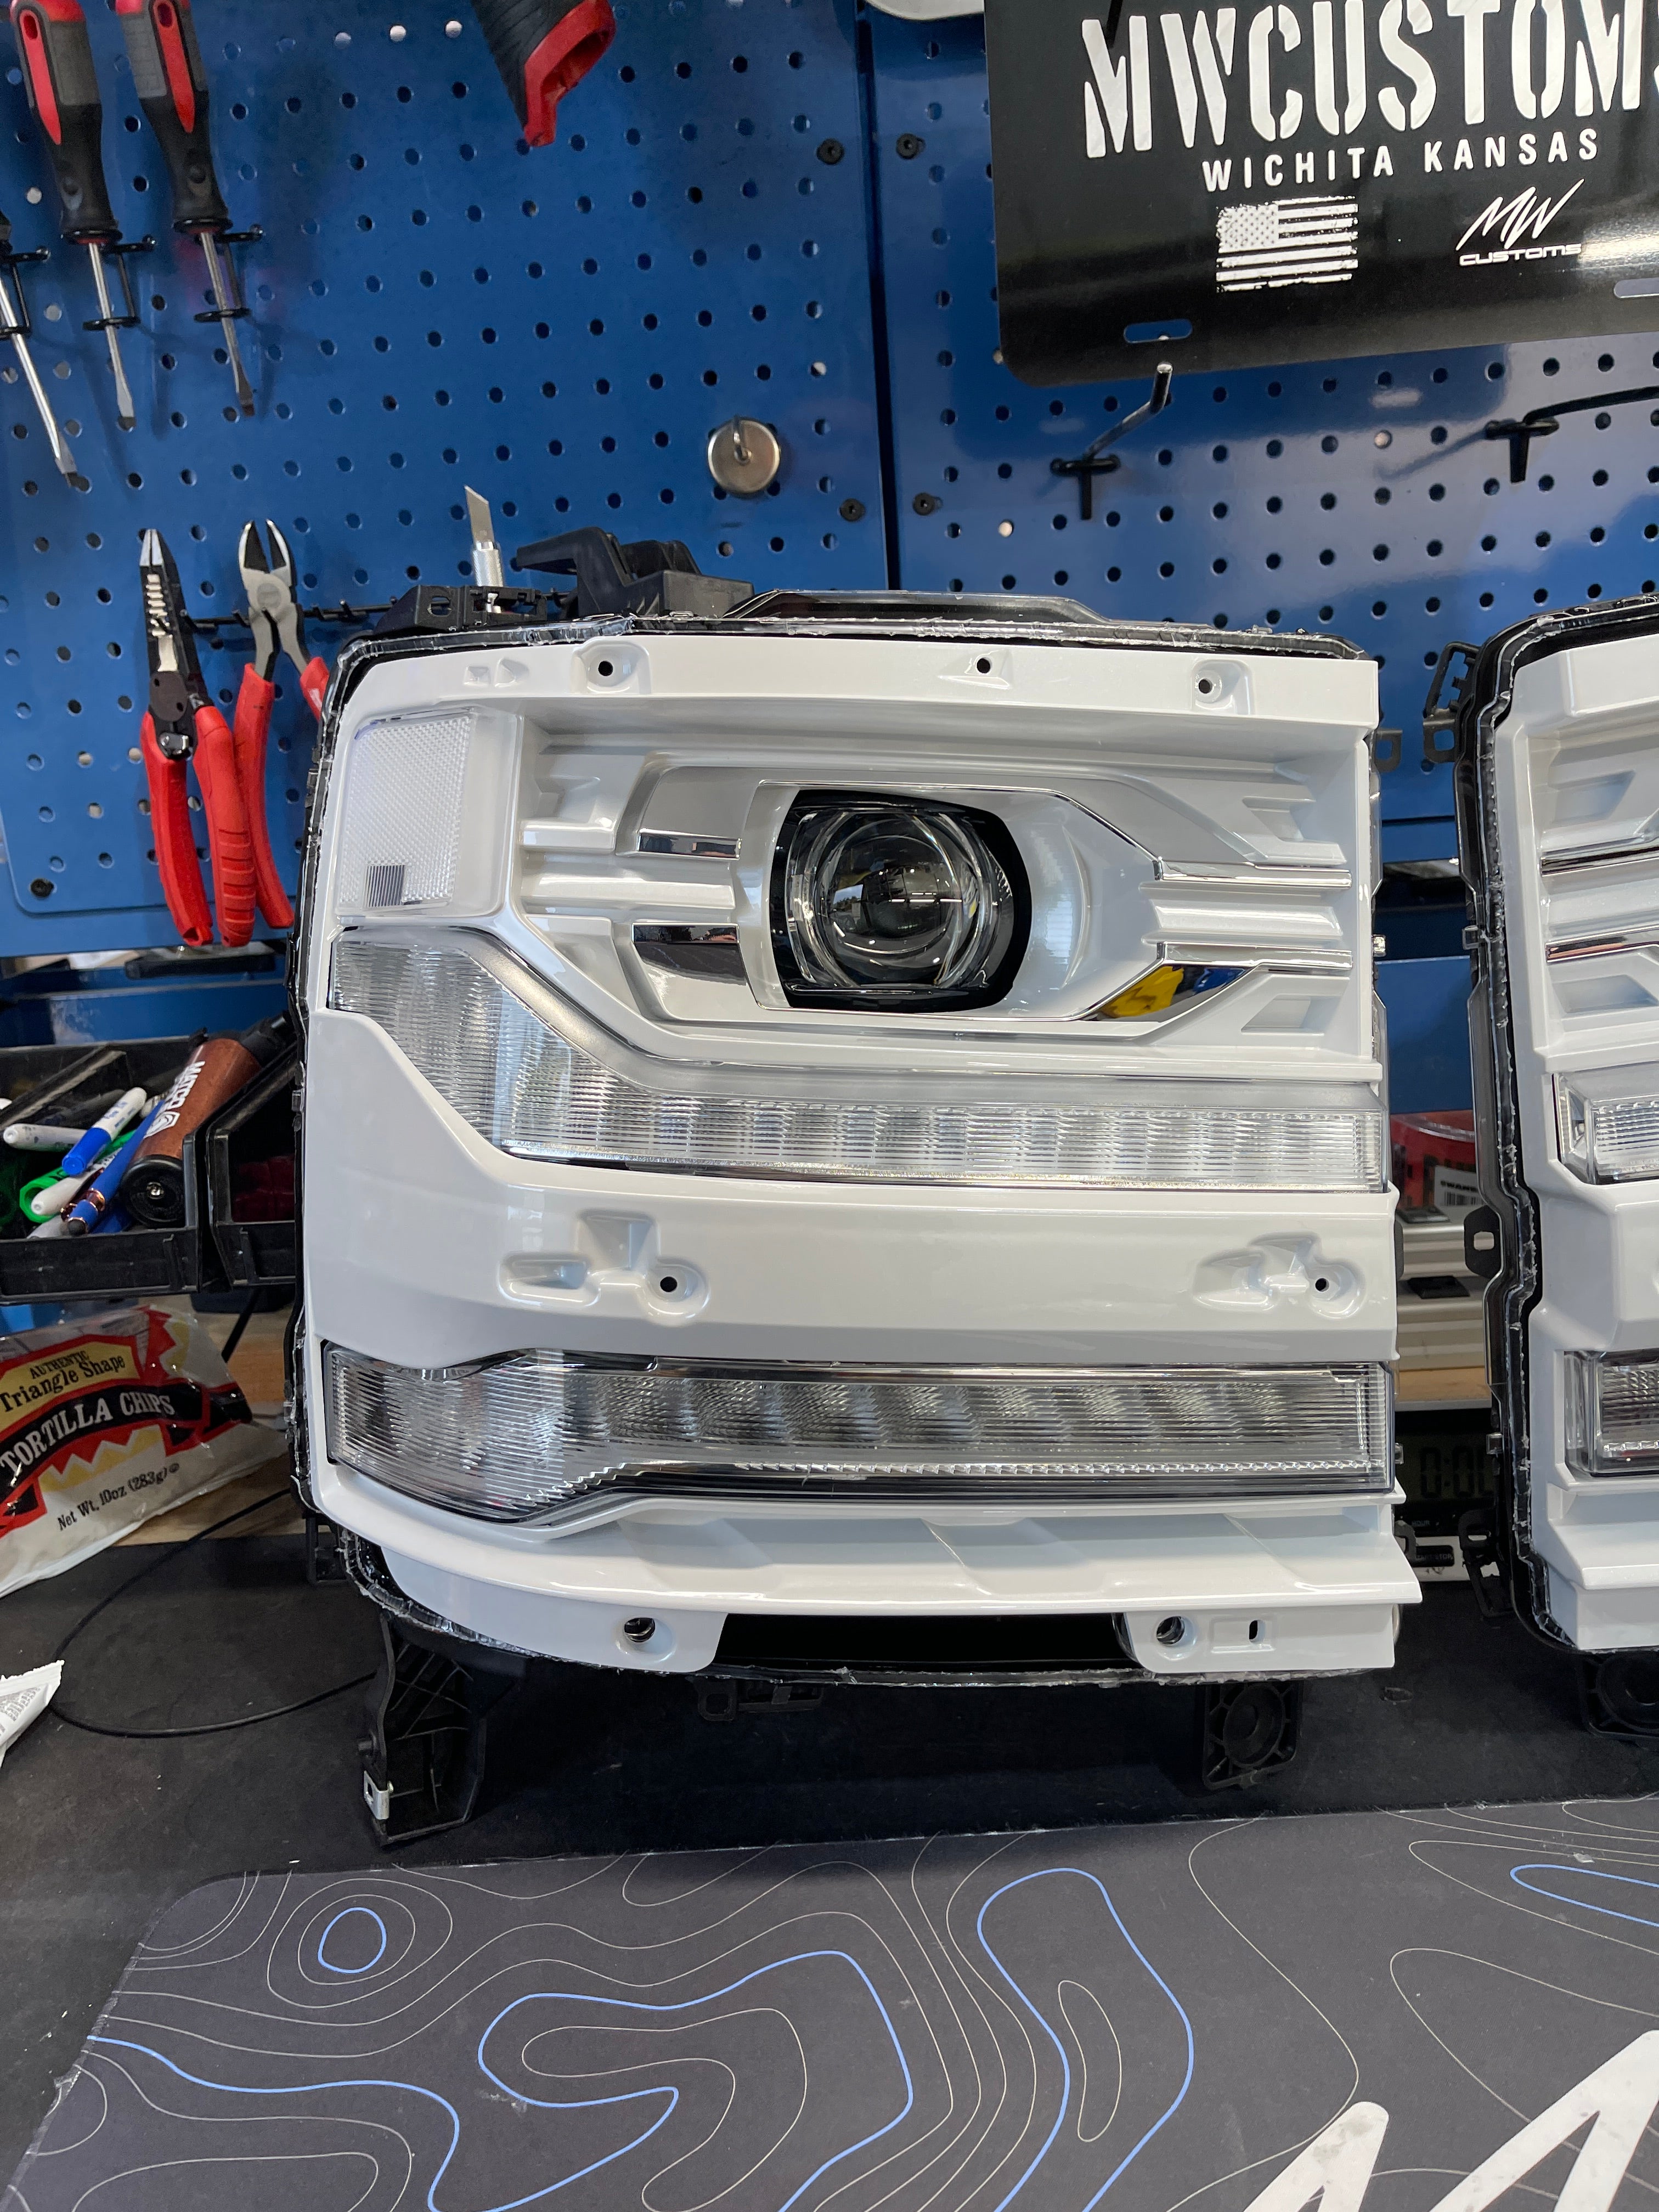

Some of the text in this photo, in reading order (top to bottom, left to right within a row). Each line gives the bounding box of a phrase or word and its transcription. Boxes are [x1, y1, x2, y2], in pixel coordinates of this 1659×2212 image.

[1081, 0, 1659, 158] MWCUSTOM
[1203, 129, 1598, 191] WICHITA KANSAS
[1455, 178, 1585, 251] MW
[1459, 242, 1582, 266] CUSTOMS
[0, 1355, 126, 1412] Triangle Shape
[29, 1350, 89, 1379] AUTHENTIC
[0, 1391, 176, 1477] TORTILLA CHIPS
[57, 1467, 167, 1531] Net Wt. 10oz (283g)
